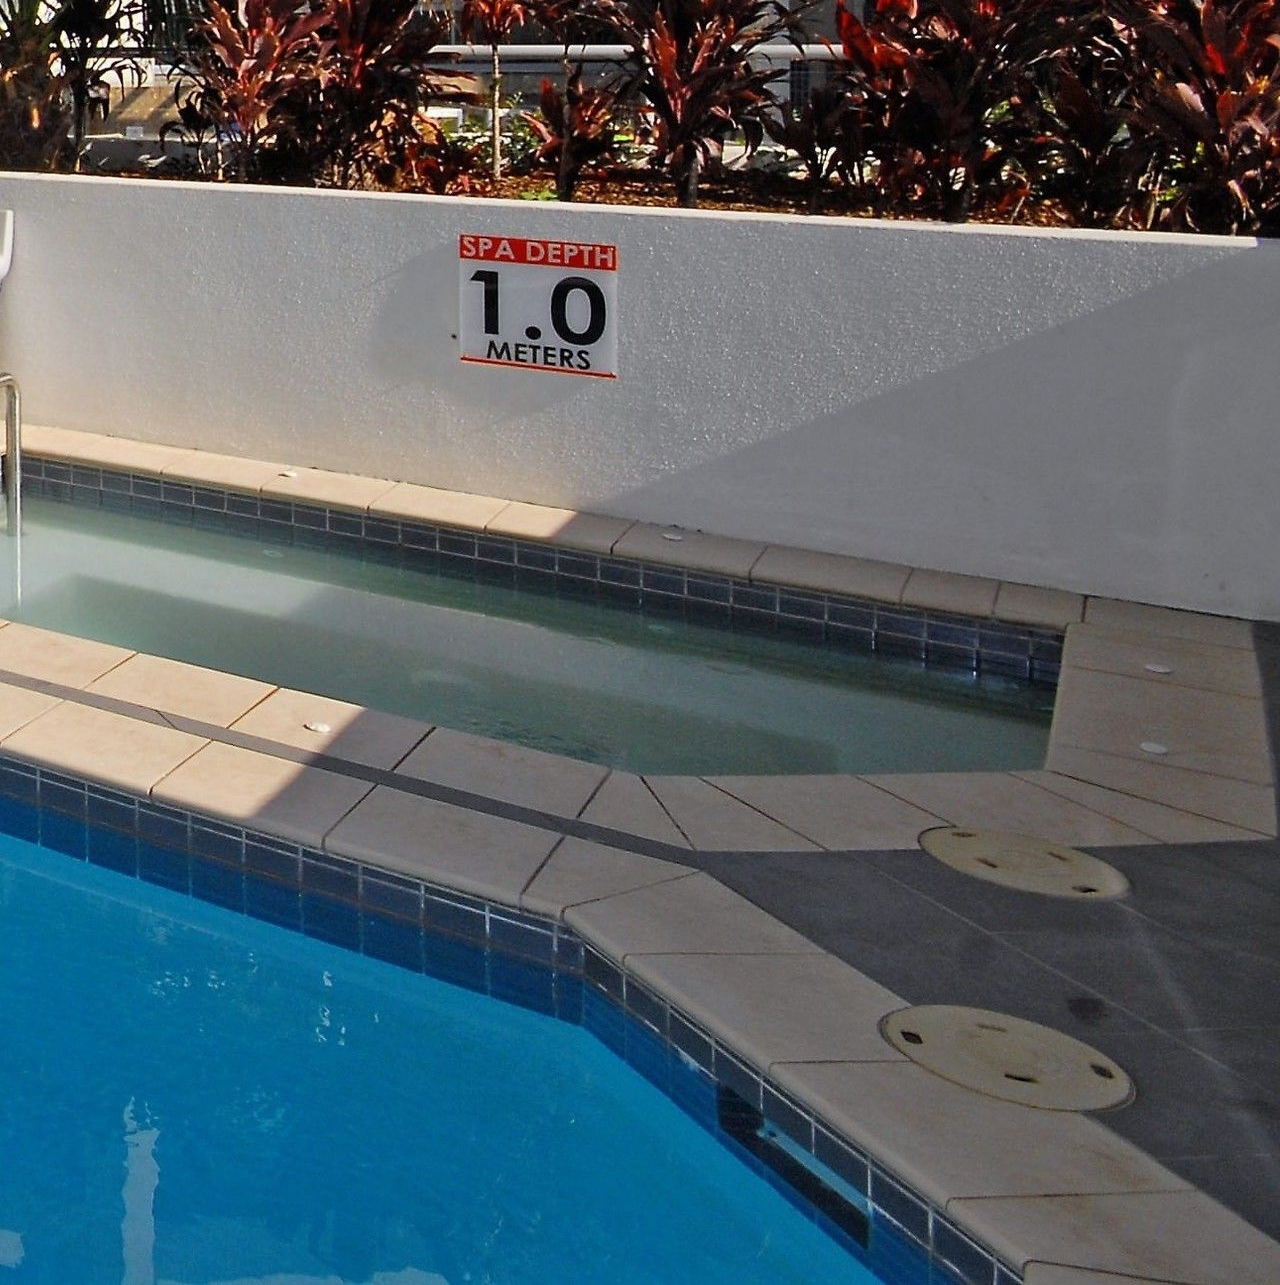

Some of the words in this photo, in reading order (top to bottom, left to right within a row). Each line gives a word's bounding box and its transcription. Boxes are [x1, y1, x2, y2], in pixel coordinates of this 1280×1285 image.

[462, 236, 515, 260] SPA
[526, 242, 614, 268] DEPTH
[470, 269, 607, 346] 1.0
[487, 340, 591, 370] METERS
